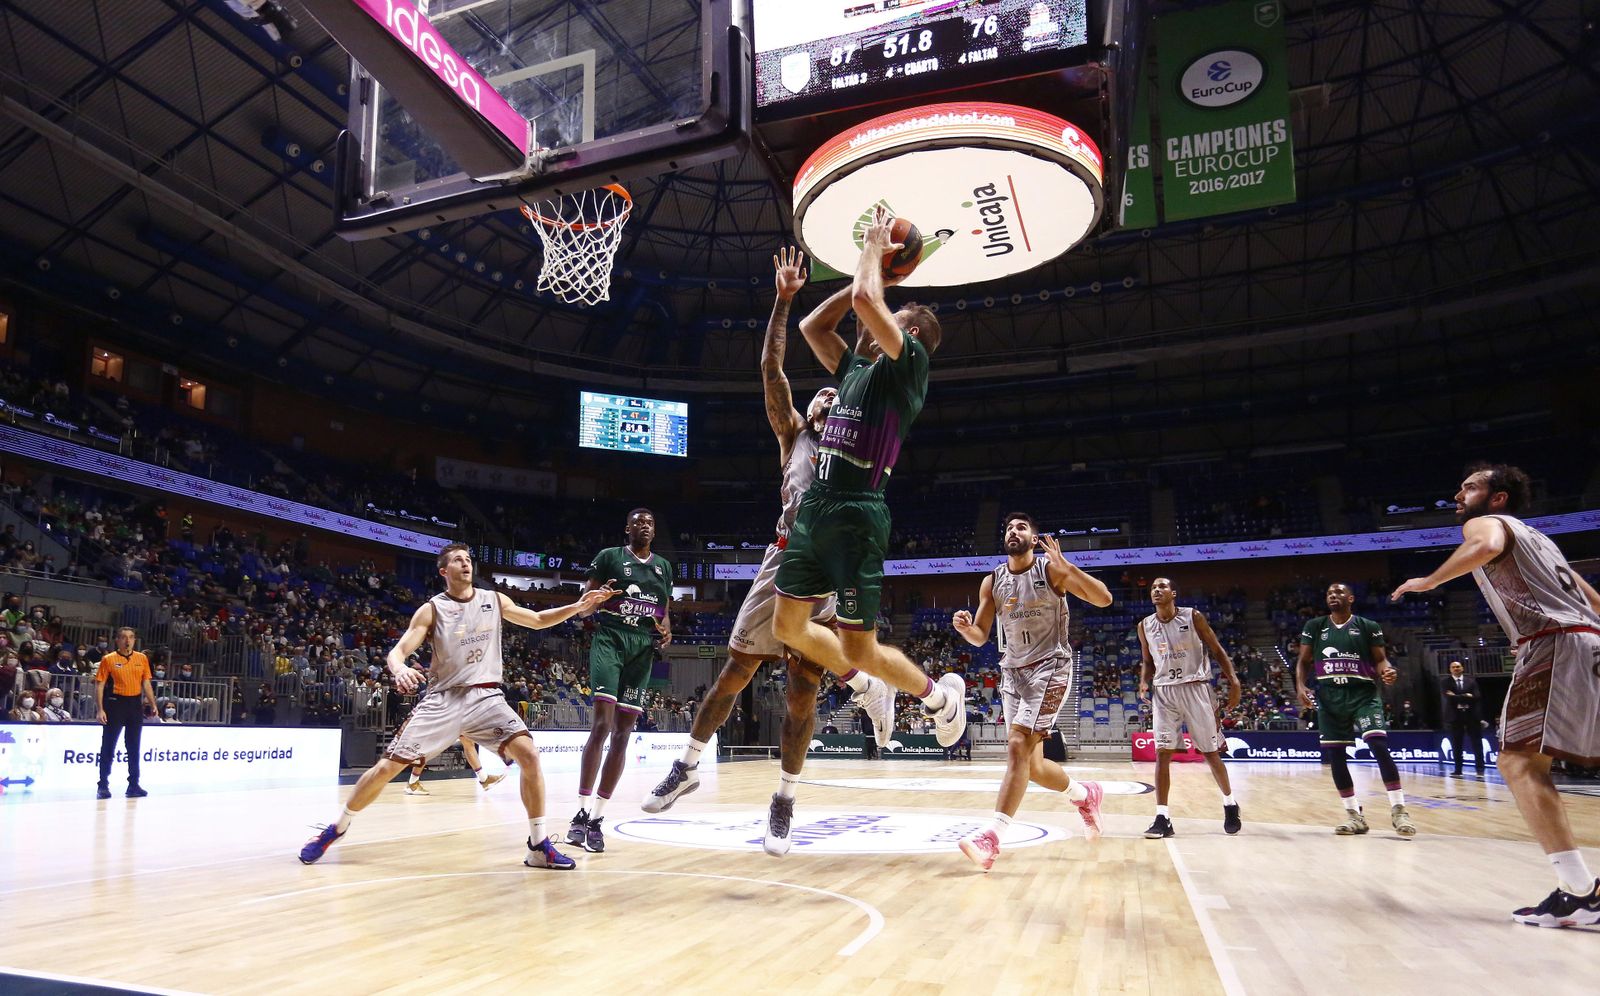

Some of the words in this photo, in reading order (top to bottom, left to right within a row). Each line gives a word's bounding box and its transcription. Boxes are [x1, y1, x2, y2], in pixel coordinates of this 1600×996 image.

[971, 15, 998, 39] 76
[883, 29, 933, 58] 51.8
[830, 43, 856, 67] 87
[958, 52, 967, 64] 4
[967, 46, 998, 64] FALTAS
[860, 72, 867, 84] 3
[1191, 81, 1253, 99] EuroCup
[1166, 119, 1287, 161] CAMPEONES
[1175, 146, 1279, 178] EUROCUP
[1189, 170, 1266, 195] 2016/2017
[961, 182, 1014, 258] Unicaja
[836, 404, 863, 419] Unicaja
[548, 557, 563, 568] 87
[1022, 630, 1031, 645] 11
[1168, 668, 1183, 680] 32
[143, 747, 208, 762] distancia
[213, 747, 229, 761] de
[233, 747, 293, 764] seguridad
[822, 744, 844, 754] Unicaja
[901, 745, 925, 754] Unicaja
[1247, 747, 1287, 759] Unicaja
[1289, 748, 1322, 758] Banco
